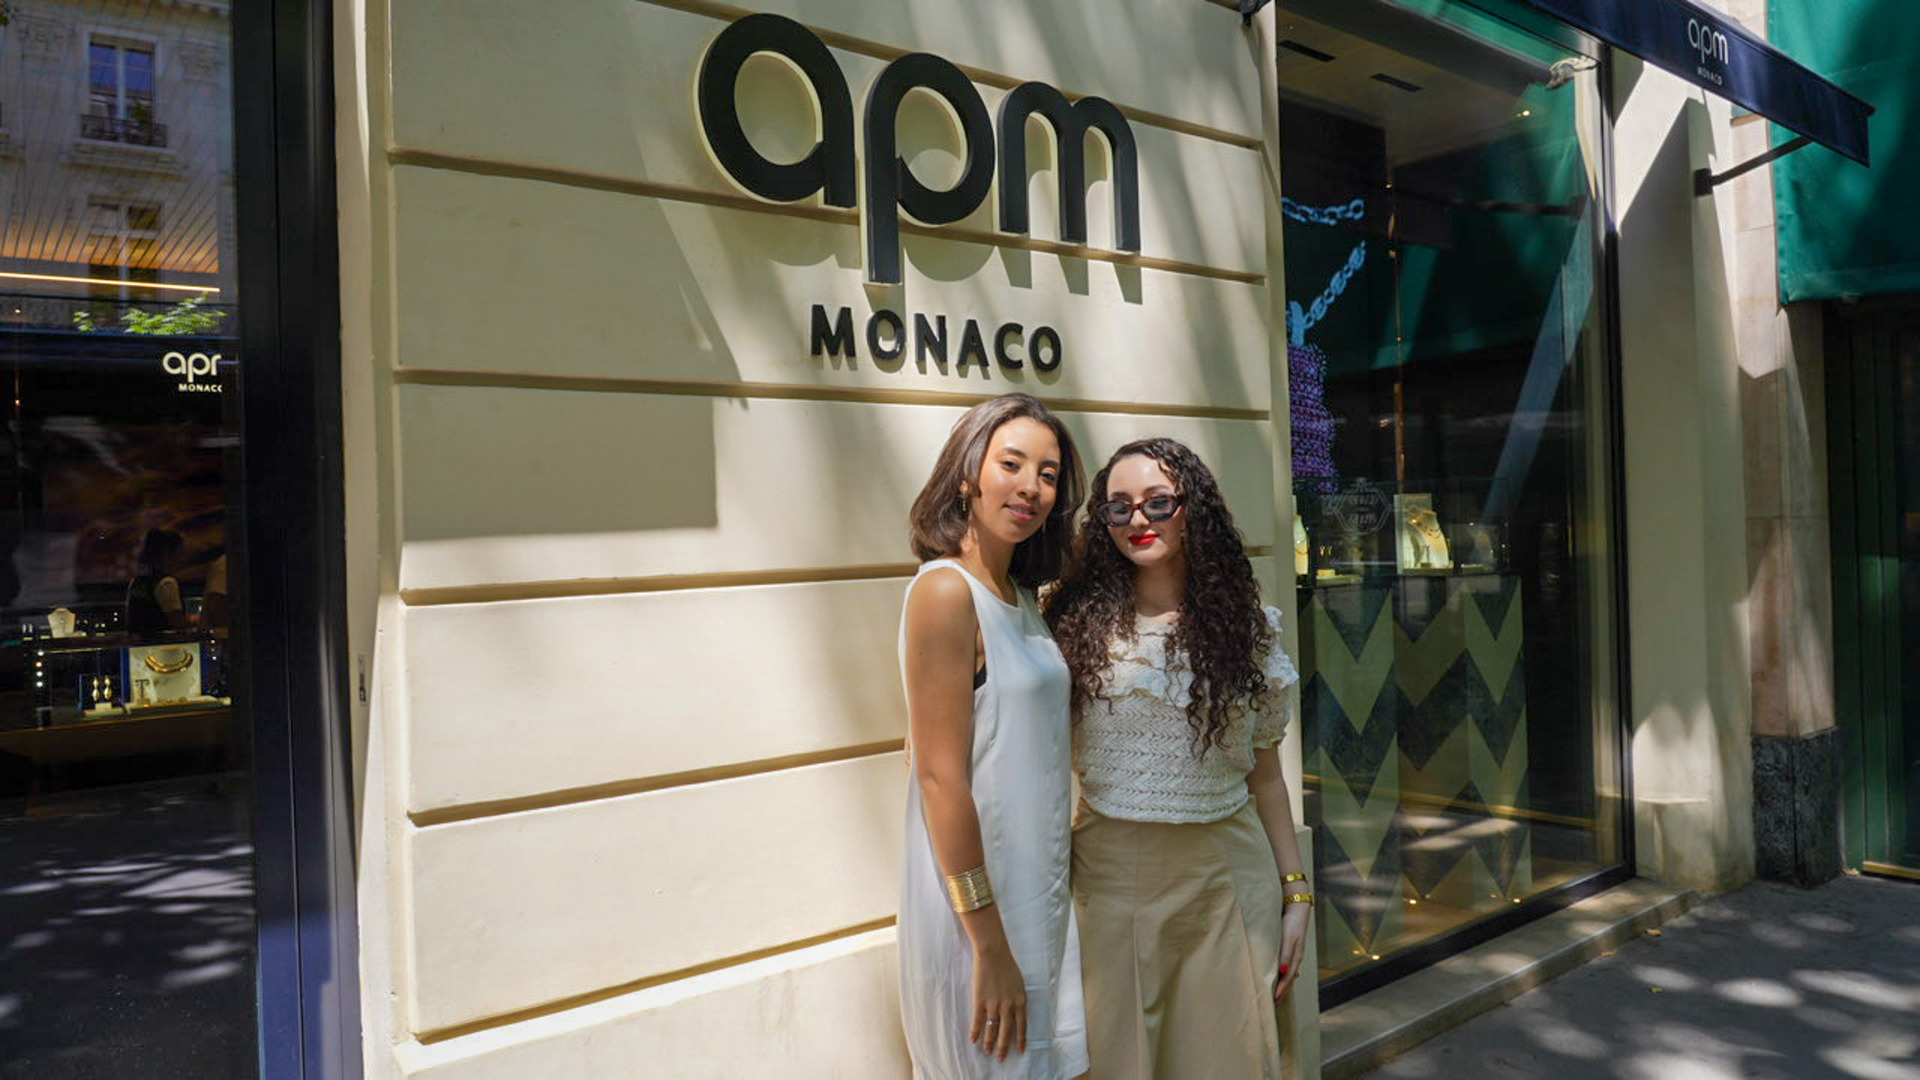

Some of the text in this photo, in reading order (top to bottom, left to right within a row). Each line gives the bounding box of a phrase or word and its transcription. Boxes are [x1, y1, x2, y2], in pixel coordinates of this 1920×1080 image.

[1688, 18, 1729, 65] apm
[696, 13, 1141, 286] apm
[811, 304, 1062, 372] MONACO
